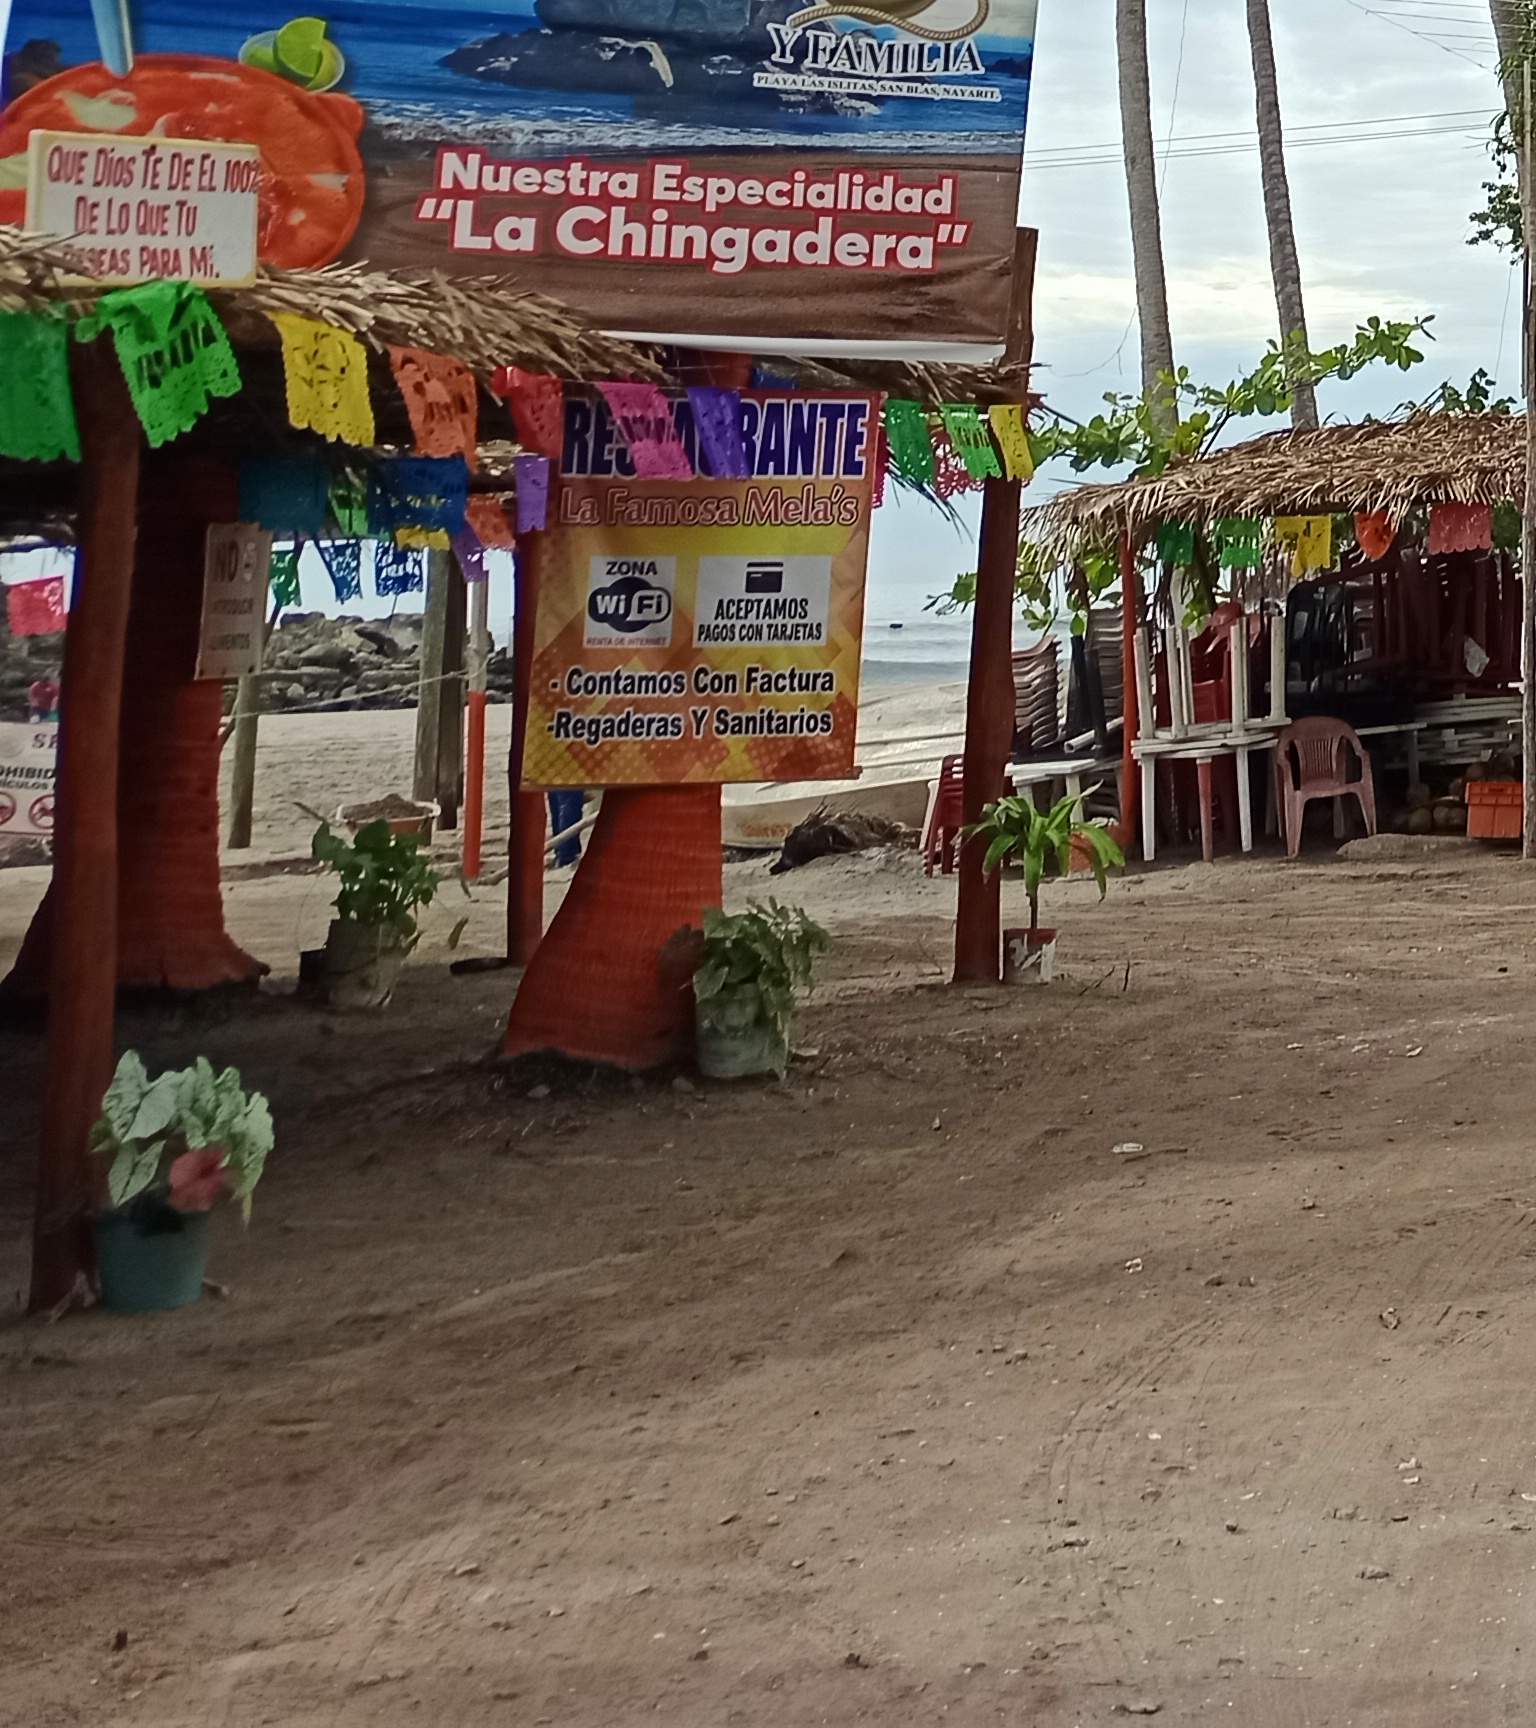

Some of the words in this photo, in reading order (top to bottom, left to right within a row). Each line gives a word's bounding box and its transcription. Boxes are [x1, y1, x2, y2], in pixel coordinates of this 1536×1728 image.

[767, 23, 802, 64] Y
[804, 29, 985, 75] FAMILIA
[756, 74, 798, 86] PLAYA
[801, 77, 824, 88] LAS
[826, 79, 878, 93] ISLITAS,
[879, 83, 904, 94] SAN
[905, 85, 941, 97] BLAS,
[942, 87, 1000, 100] NAYARIT.
[48, 145, 88, 186] QUE
[142, 144, 163, 191] TE
[167, 151, 195, 191] DE
[197, 152, 217, 193] EL
[440, 151, 637, 200] Nuestra
[652, 162, 953, 215] Especialidad
[74, 194, 100, 235] DE
[105, 196, 130, 236] LO
[136, 198, 171, 237] QUE
[175, 199, 198, 237] TU
[138, 244, 183, 278] PARA
[559, 486, 599, 524] La
[606, 487, 740, 527] Famosa
[743, 482, 859, 527] Mela's
[605, 560, 658, 576] ZONA
[713, 597, 809, 622] ACEPTAMOS
[698, 623, 736, 643] PAGOS
[737, 624, 765, 643] CON
[765, 622, 822, 642] TARJETAS
[565, 666, 686, 696] Contamos
[693, 668, 738, 694] Con
[744, 666, 835, 694] Factura
[689, 707, 708, 736] Y
[713, 707, 833, 736] Sanitarios
